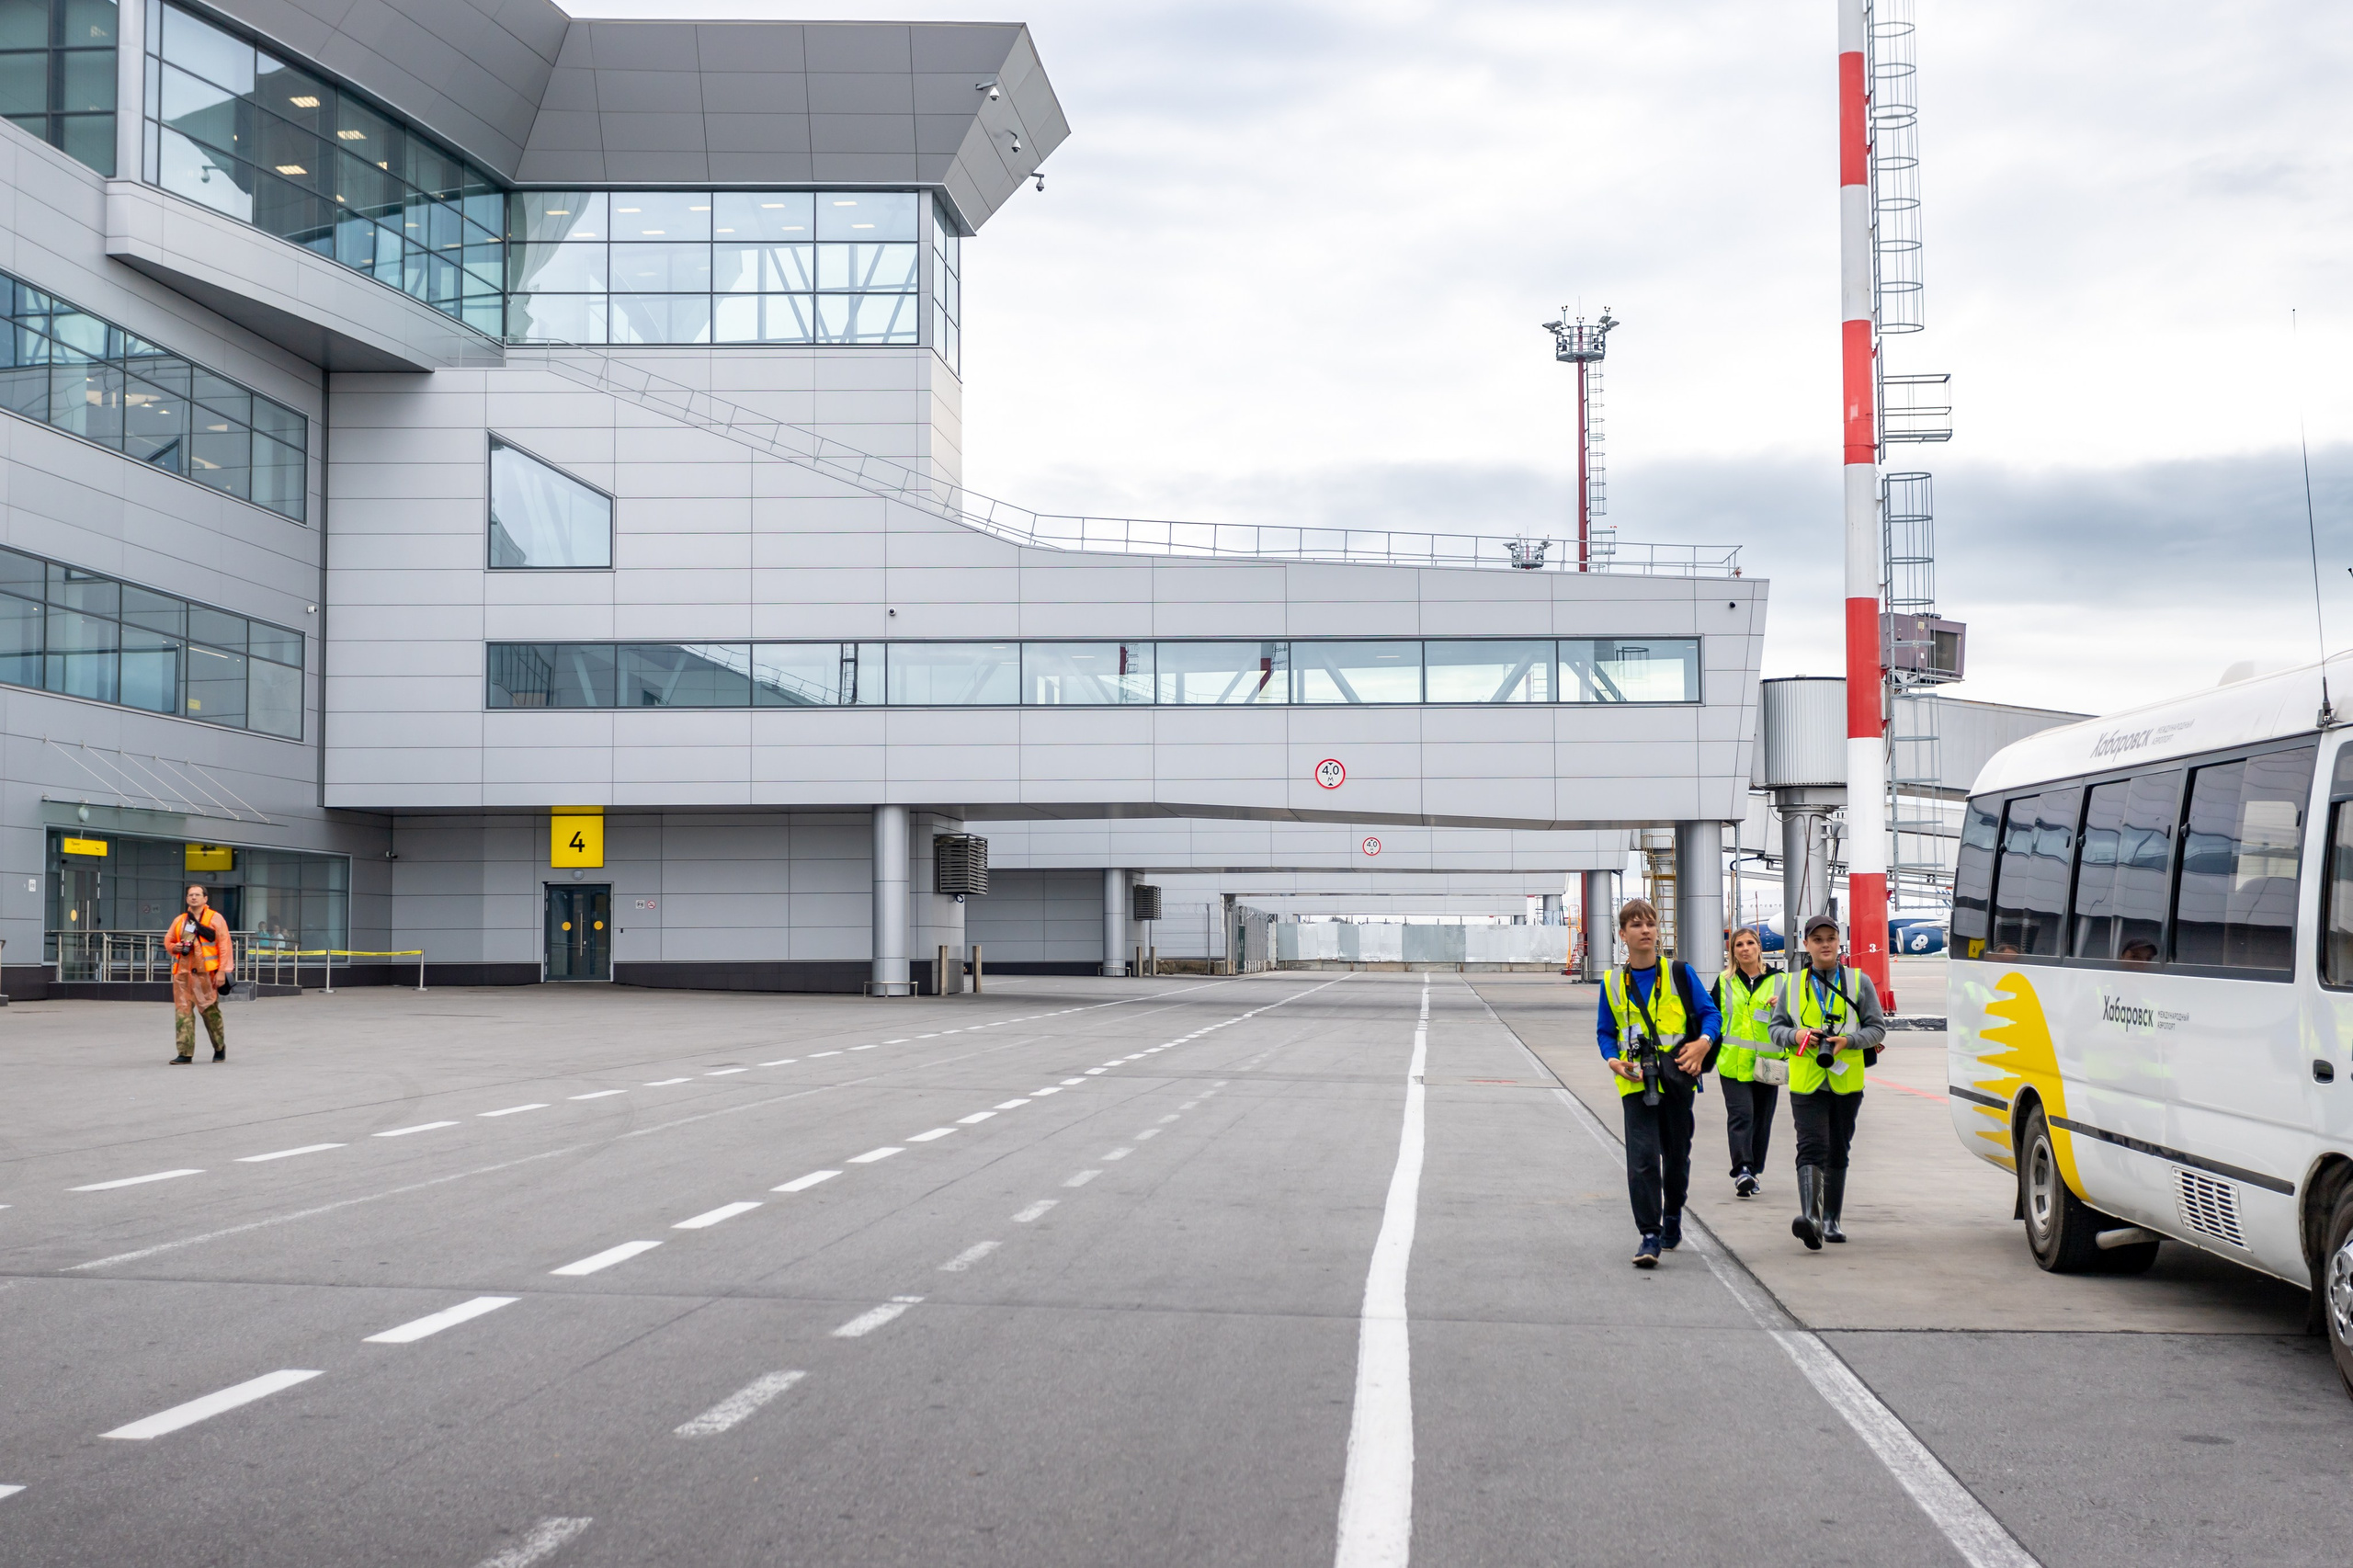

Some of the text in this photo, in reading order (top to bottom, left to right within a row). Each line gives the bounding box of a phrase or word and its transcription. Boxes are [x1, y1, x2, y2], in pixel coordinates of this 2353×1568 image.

[2089, 729, 2154, 762] Хабаровск
[569, 831, 585, 853] 4
[1869, 943, 1877, 953] 3
[2102, 994, 2154, 1032] Хабаровск
